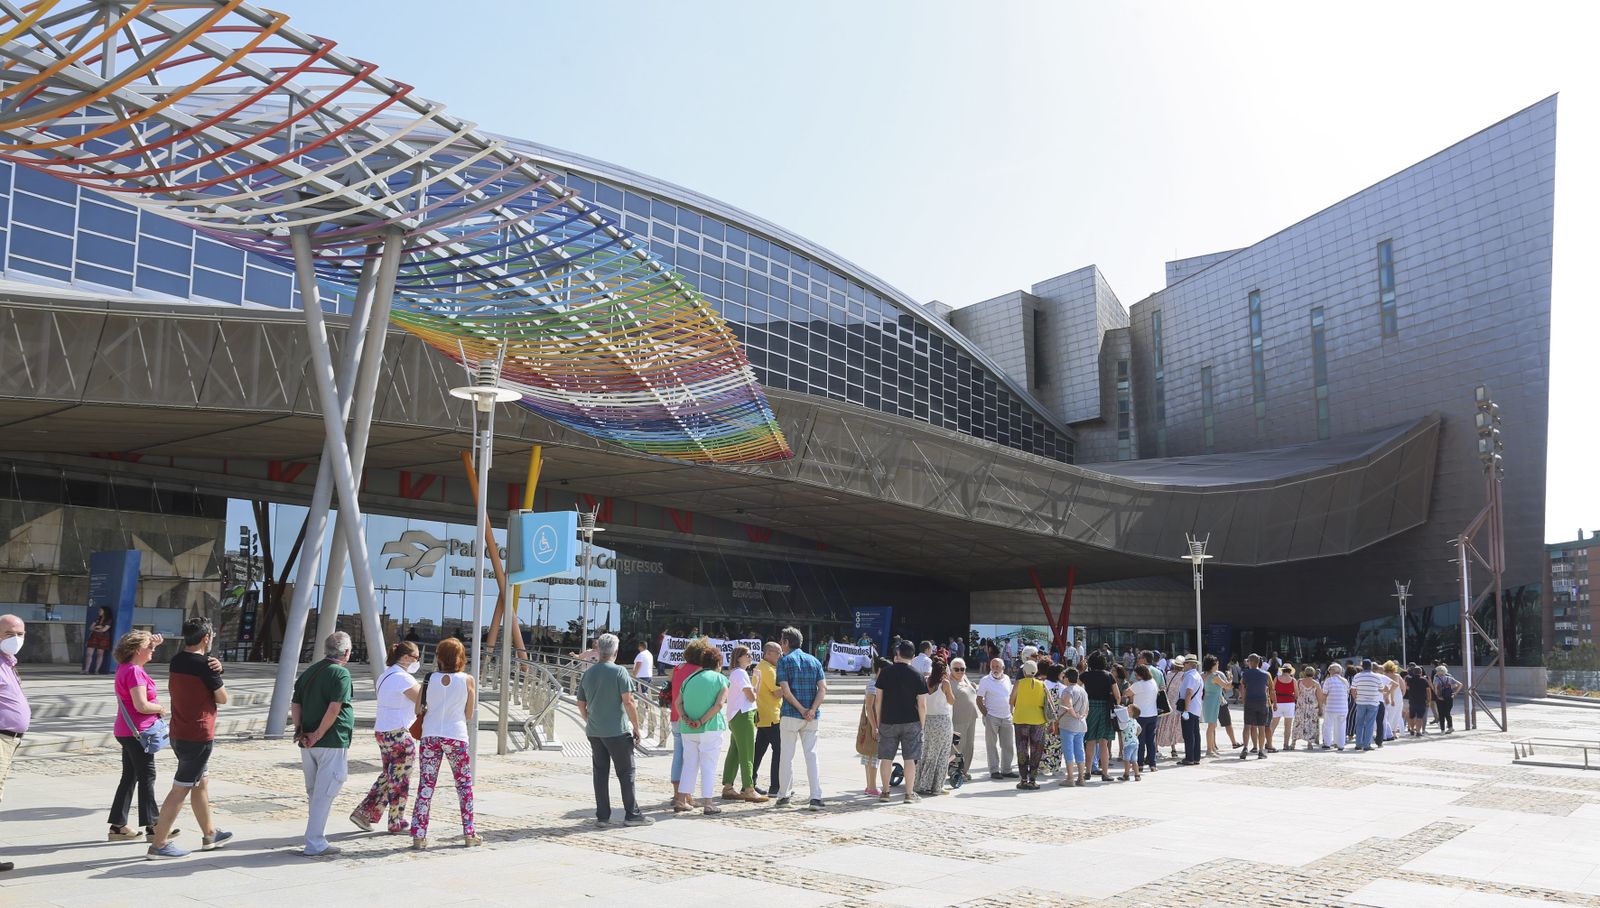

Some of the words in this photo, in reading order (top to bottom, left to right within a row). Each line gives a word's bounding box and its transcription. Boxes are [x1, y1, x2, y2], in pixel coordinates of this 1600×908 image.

[450, 538, 508, 560] Palco
[597, 553, 664, 574] Congresos
[450, 566, 476, 577] Trad
